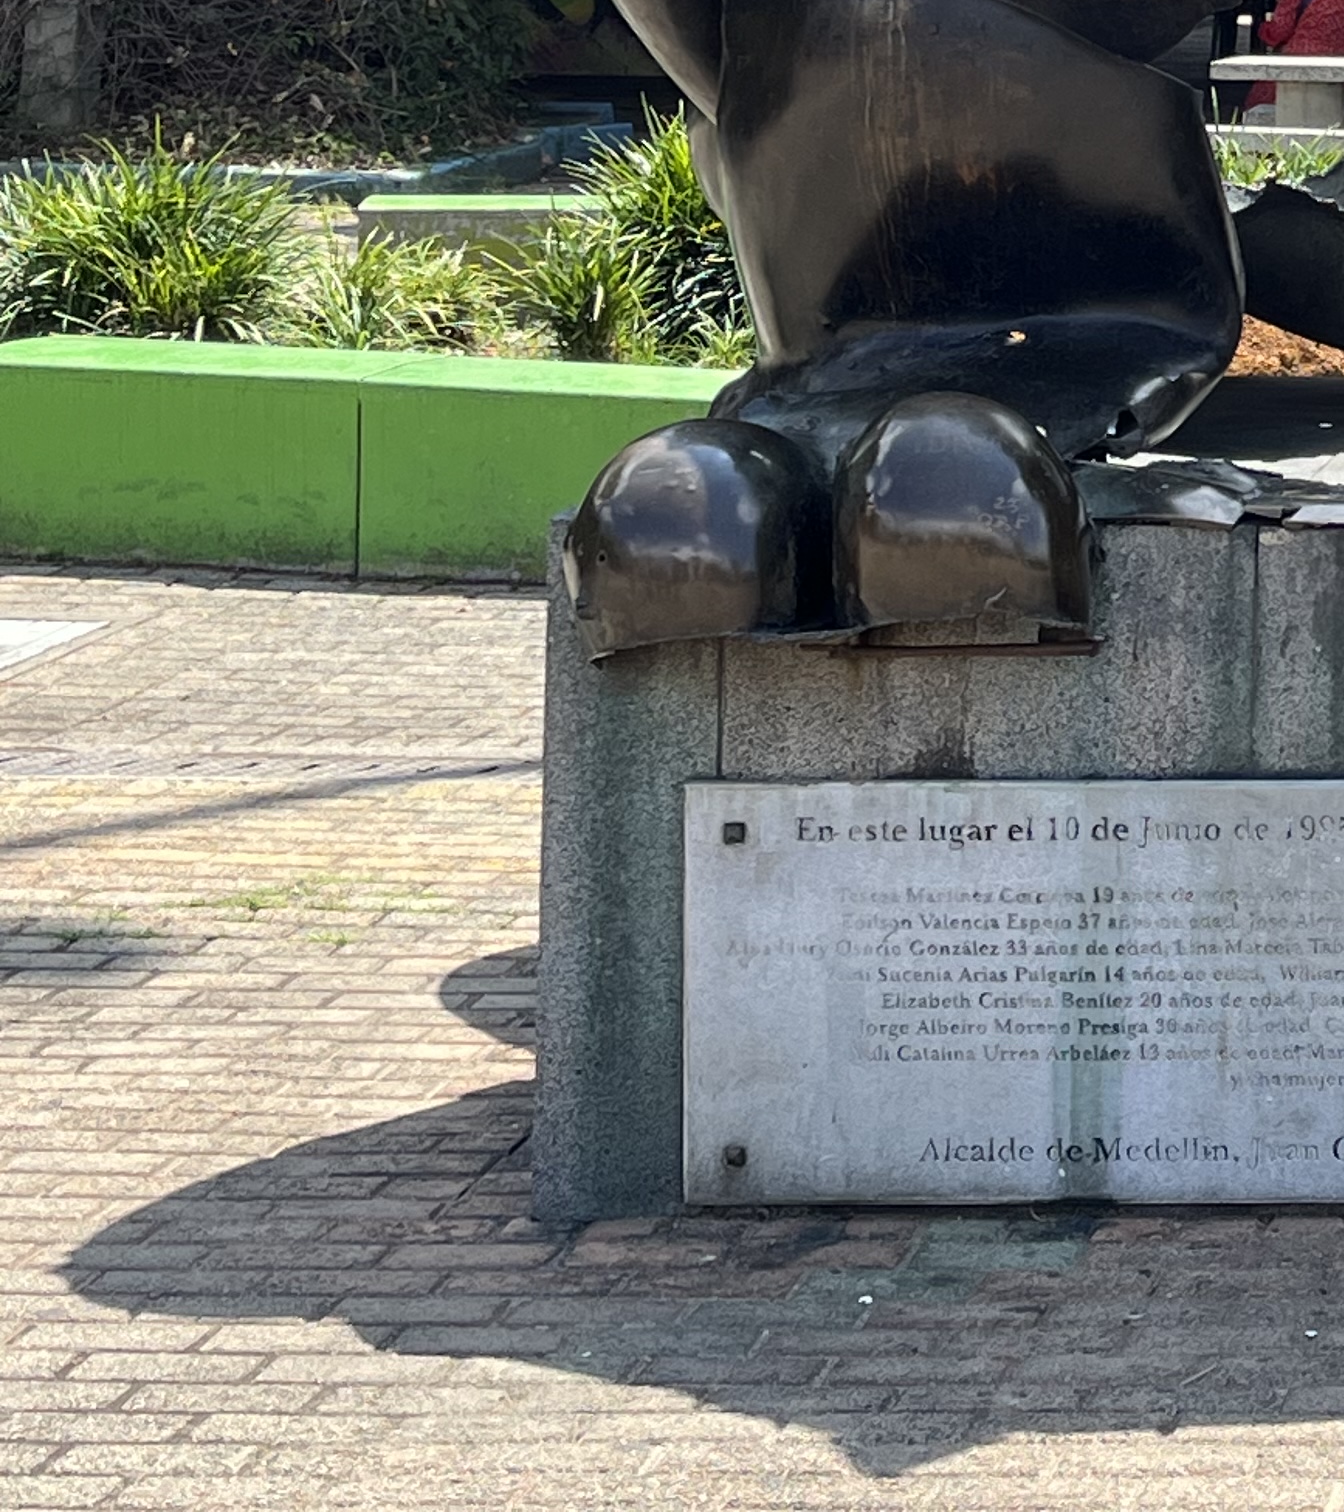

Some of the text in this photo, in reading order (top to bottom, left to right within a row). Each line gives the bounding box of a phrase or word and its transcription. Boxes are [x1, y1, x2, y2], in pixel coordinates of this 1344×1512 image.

[796, 816, 836, 842] En
[848, 820, 907, 842] este
[918, 816, 998, 850] lugar
[1007, 815, 1035, 841] el
[1048, 817, 1081, 842] 10
[1090, 815, 1130, 842] de
[1138, 816, 1221, 848] Junio
[1234, 816, 1269, 842] de
[918, 913, 1001, 931] Valencia
[1077, 913, 1100, 930] 37
[909, 938, 1000, 957] González
[1005, 940, 1028, 956] 33
[1034, 939, 1079, 956] años
[1085, 939, 1110, 956] de
[877, 966, 954, 984] Sucenia
[958, 966, 1009, 983] Arias
[1014, 965, 1096, 987] Pulgarín
[1104, 966, 1126, 983] 14
[881, 991, 972, 1010] Elizabeth
[1139, 991, 1163, 1009] 20
[1167, 991, 1214, 1010] años
[916, 1017, 988, 1036] Albeiro
[993, 1018, 1072, 1036] Moreno
[1077, 1017, 1150, 1040] Presiga
[896, 1044, 976, 1062] Catalina
[983, 1043, 1040, 1062] Urrea
[1045, 1043, 1132, 1062] Arbeláez
[1138, 1043, 1160, 1061] 13
[918, 1135, 1035, 1163] Alcalde
[1045, 1136, 1086, 1163] de
[1246, 1135, 1321, 1169] Juan
